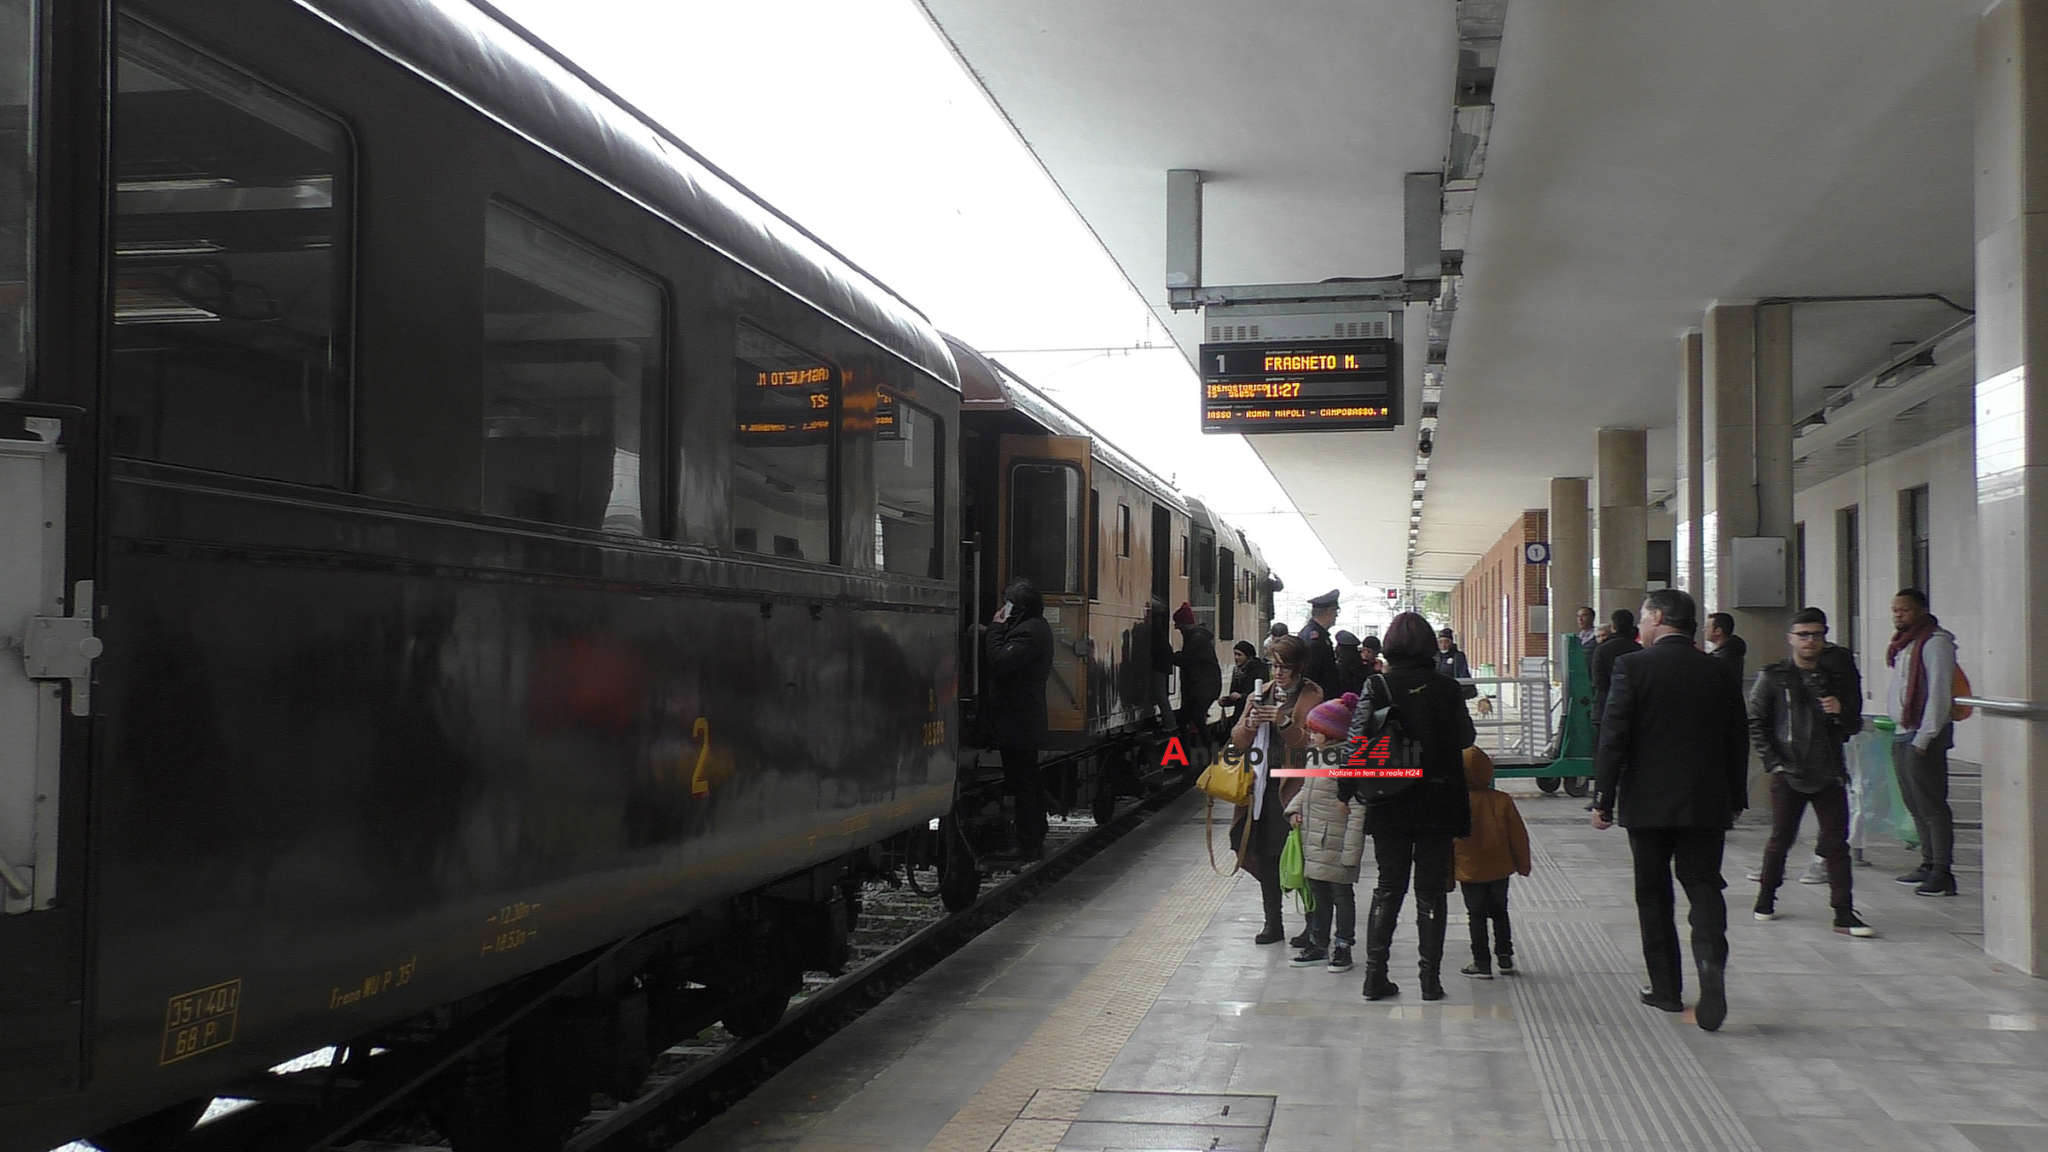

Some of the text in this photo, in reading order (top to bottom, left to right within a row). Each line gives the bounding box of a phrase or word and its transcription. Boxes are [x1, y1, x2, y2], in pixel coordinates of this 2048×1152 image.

[1215, 354, 1226, 373] 1
[1265, 354, 1360, 371] FRAGNETO M.
[1266, 383, 1301, 398] 11:27
[691, 716, 710, 796] 2
[175, 1018, 217, 1055] 68 P
